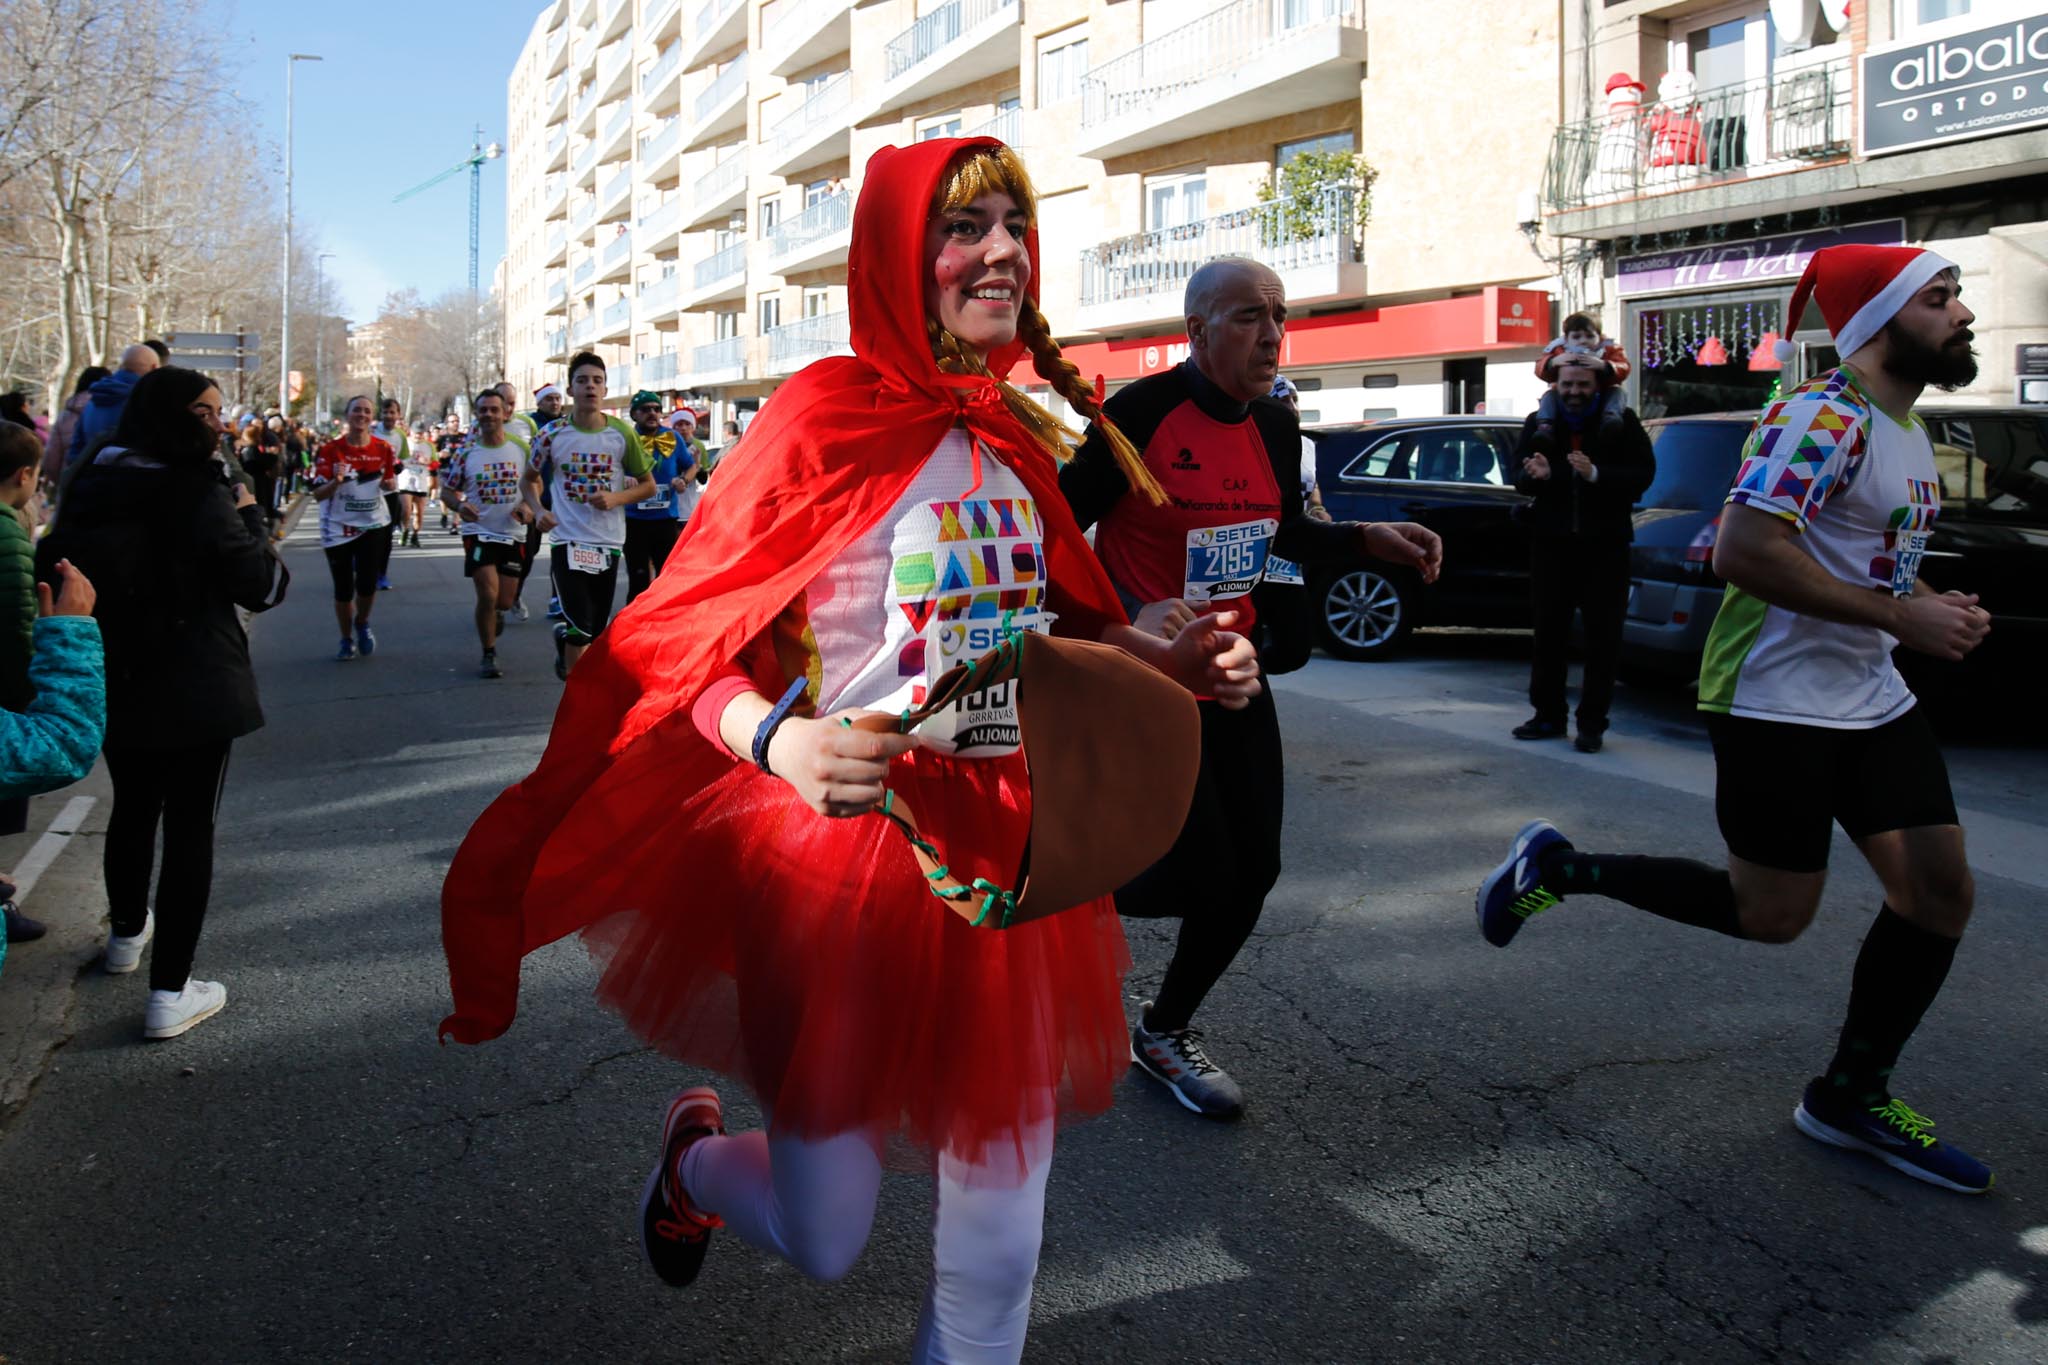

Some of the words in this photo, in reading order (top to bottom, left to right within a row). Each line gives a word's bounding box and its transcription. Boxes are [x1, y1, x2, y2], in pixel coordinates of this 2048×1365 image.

[1232, 499, 1242, 511] de
[573, 550, 601, 565] 6693
[1204, 541, 1254, 576] 2195
[968, 707, 1014, 724] GRRRIVAS
